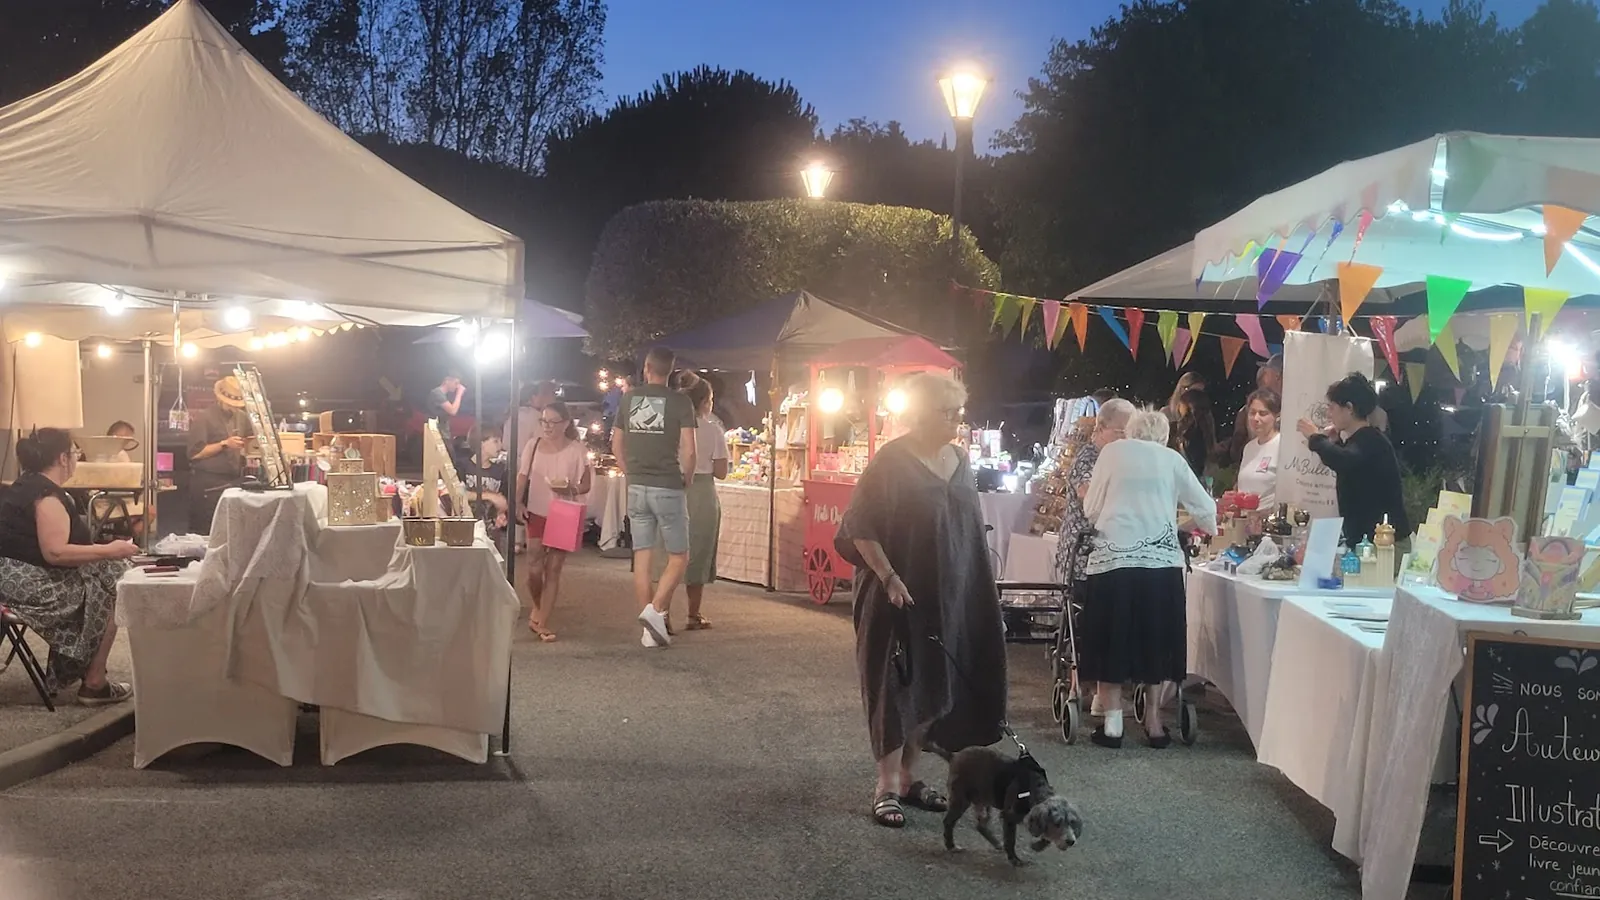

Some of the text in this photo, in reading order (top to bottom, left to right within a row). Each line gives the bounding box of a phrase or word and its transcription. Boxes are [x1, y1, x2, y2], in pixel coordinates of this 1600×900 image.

[1520, 682, 1562, 697] NOUS
[1529, 835, 1600, 857] Découvre
[1529, 853, 1600, 880] livre jeun
